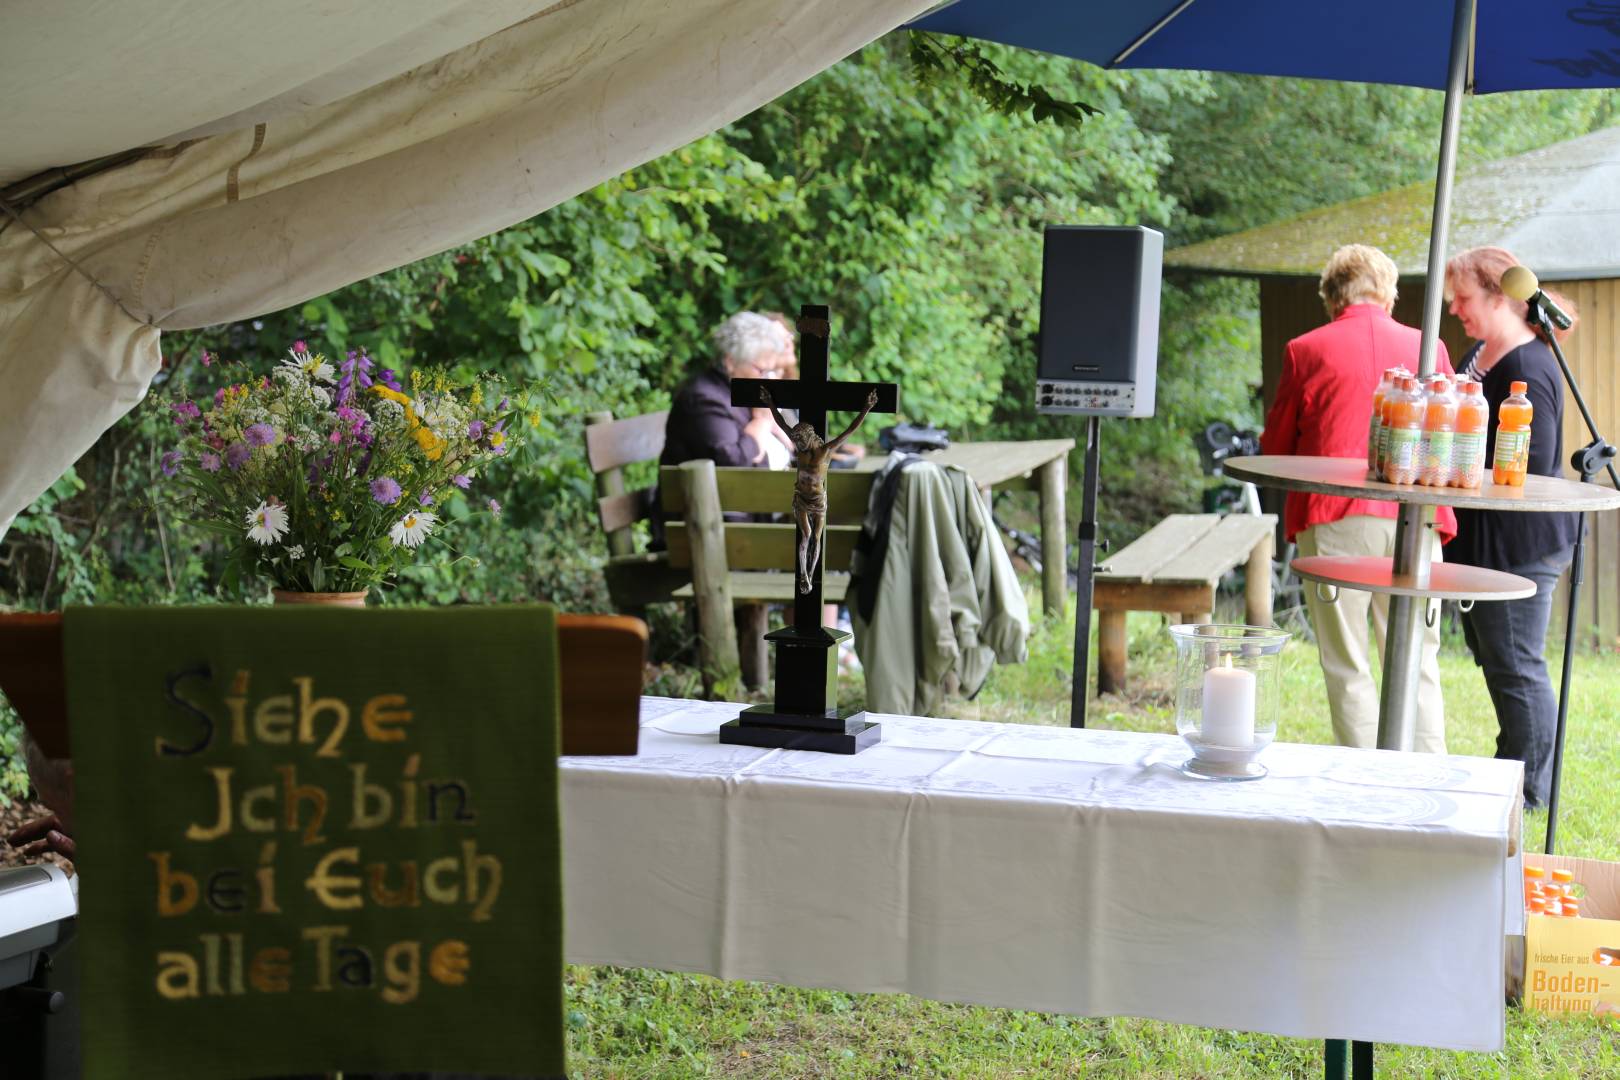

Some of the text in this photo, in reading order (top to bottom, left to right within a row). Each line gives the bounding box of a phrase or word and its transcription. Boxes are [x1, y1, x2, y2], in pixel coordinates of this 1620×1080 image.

[154, 662, 413, 757] Siehe
[347, 753, 477, 829] bin
[148, 838, 503, 922] bei Euch
[155, 925, 471, 1004] alle Tage
[1532, 969, 1610, 993] Boden-
[1534, 953, 1590, 965] frische Eier aus
